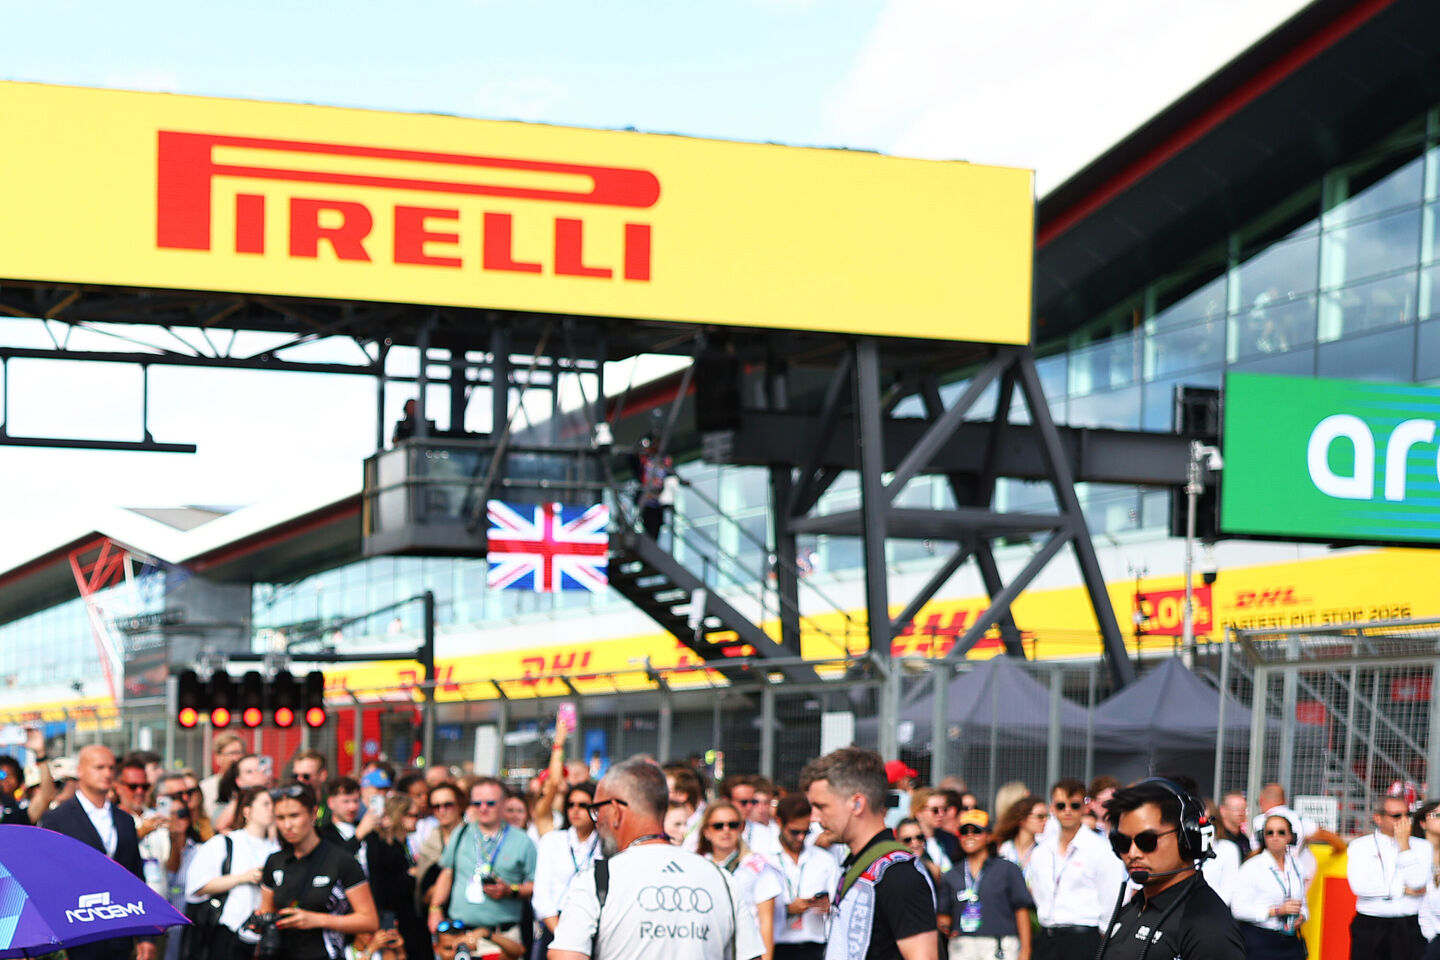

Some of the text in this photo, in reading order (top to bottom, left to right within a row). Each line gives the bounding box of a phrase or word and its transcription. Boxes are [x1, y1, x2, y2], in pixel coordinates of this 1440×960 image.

[156, 130, 661, 282] PIRELLI
[1307, 413, 1440, 502] ar
[1234, 586, 1300, 608] DHL
[521, 650, 597, 687] DHL
[64, 900, 146, 923] ACADEMY
